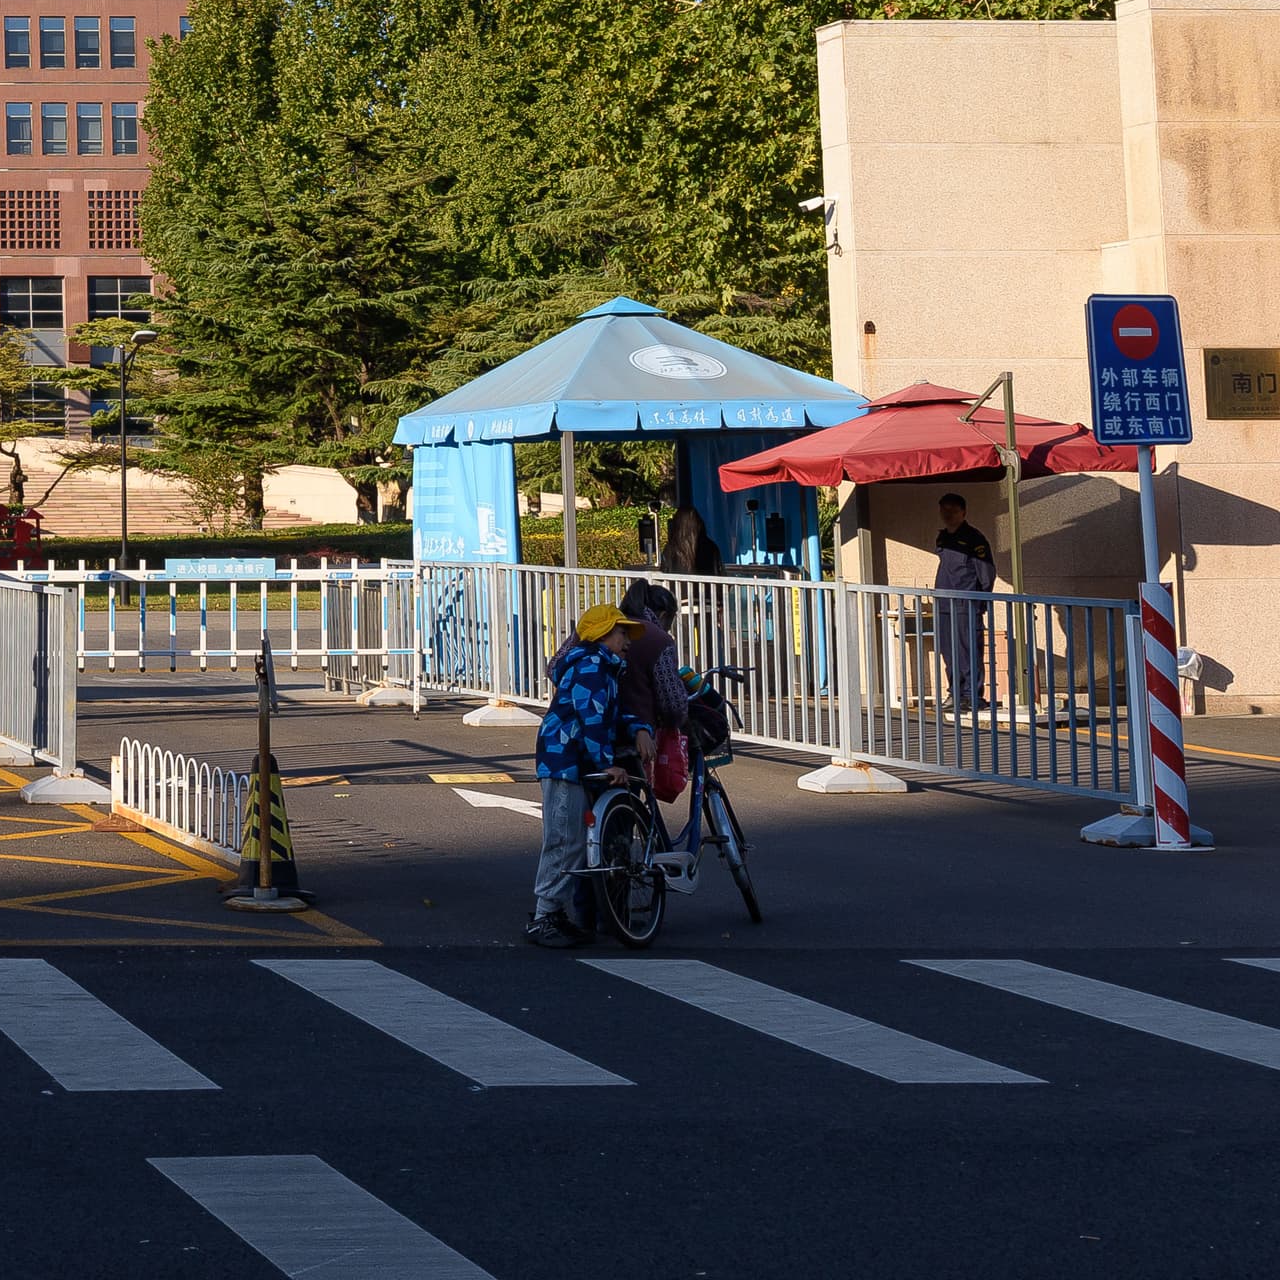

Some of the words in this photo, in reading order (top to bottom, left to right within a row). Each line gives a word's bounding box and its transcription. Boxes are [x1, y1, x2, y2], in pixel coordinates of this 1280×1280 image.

[1101, 367, 1179, 388] 外部车辆
[1231, 372, 1277, 394] 南门
[1103, 392, 1181, 412] 绕行西门
[1104, 415, 1185, 436] 或东南门
